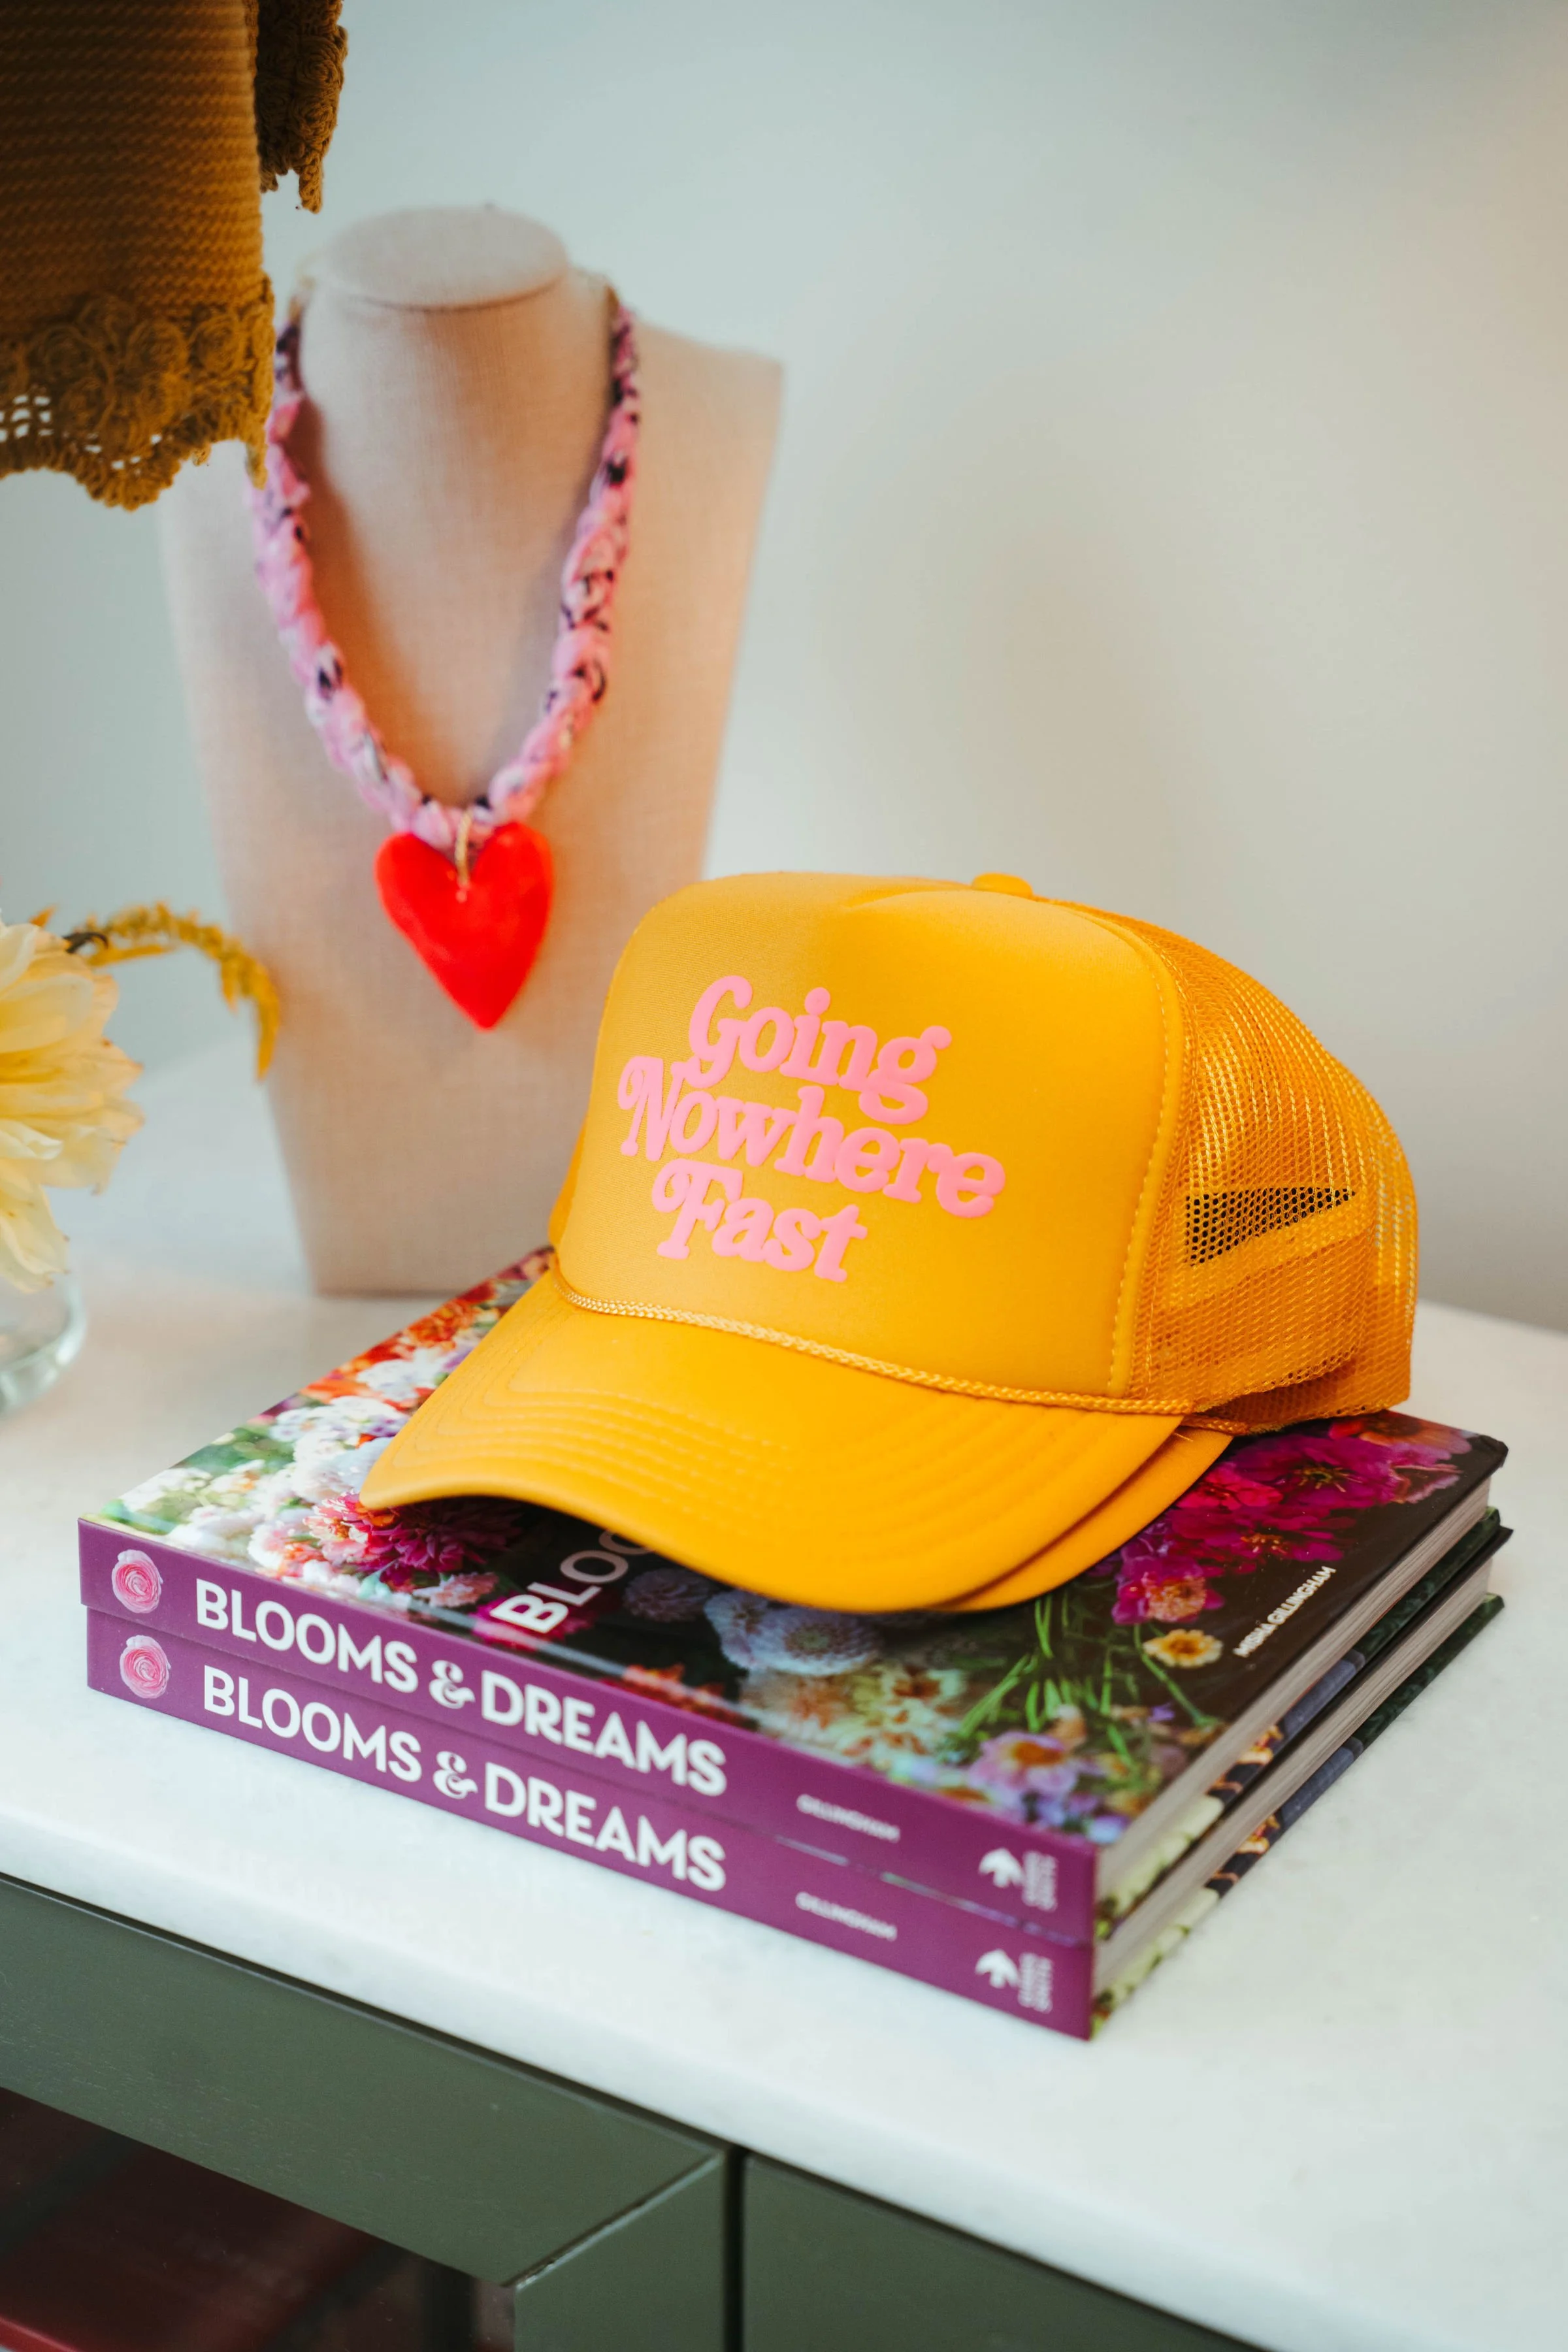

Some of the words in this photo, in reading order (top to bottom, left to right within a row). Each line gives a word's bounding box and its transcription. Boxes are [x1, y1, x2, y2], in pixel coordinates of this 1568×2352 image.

[689, 975, 953, 1125] Going
[617, 1055, 1005, 1218] Nowhere
[651, 1158, 868, 1282] Fast
[1267, 1565, 1337, 1625] GILLINGHAM
[196, 1578, 419, 1693] BLOOMS
[429, 1660, 476, 1710] &
[481, 1669, 727, 1797] DREAMS
[204, 1665, 423, 1783] BLOOMS
[433, 1750, 479, 1800] &
[484, 1761, 727, 1891] DREAMS
